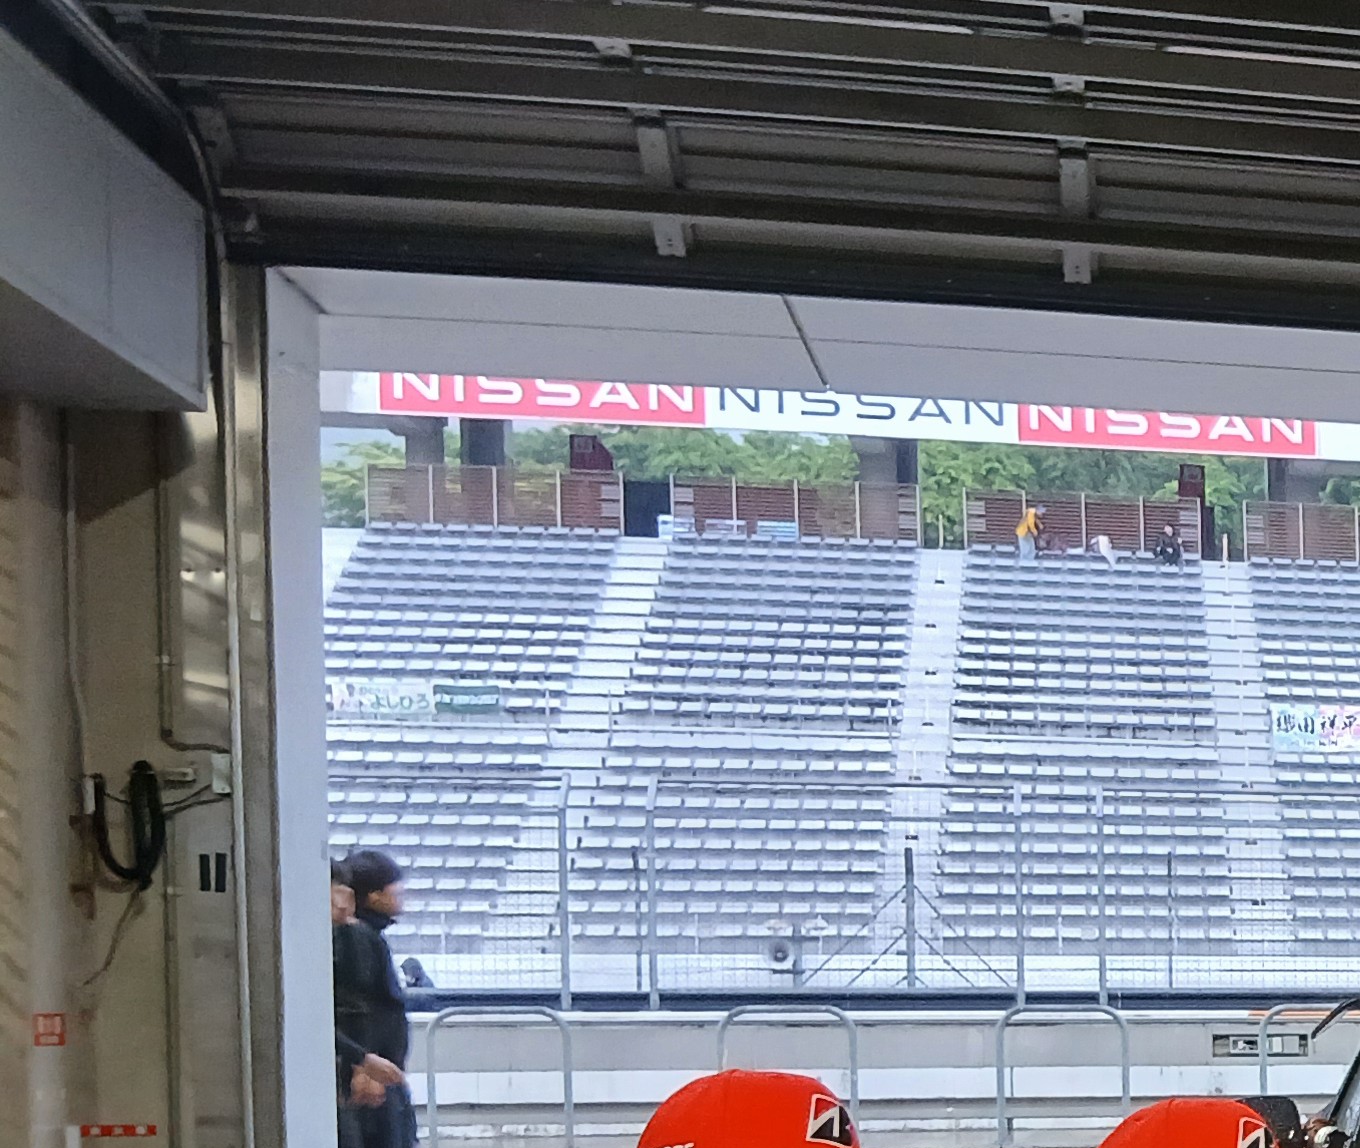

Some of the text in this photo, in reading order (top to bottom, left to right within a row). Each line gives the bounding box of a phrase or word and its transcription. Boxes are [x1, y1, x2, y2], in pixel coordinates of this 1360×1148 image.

[392, 372, 694, 413] NISSAN
[719, 387, 1005, 426] NISSAN
[1028, 404, 1303, 444] NISSAN
